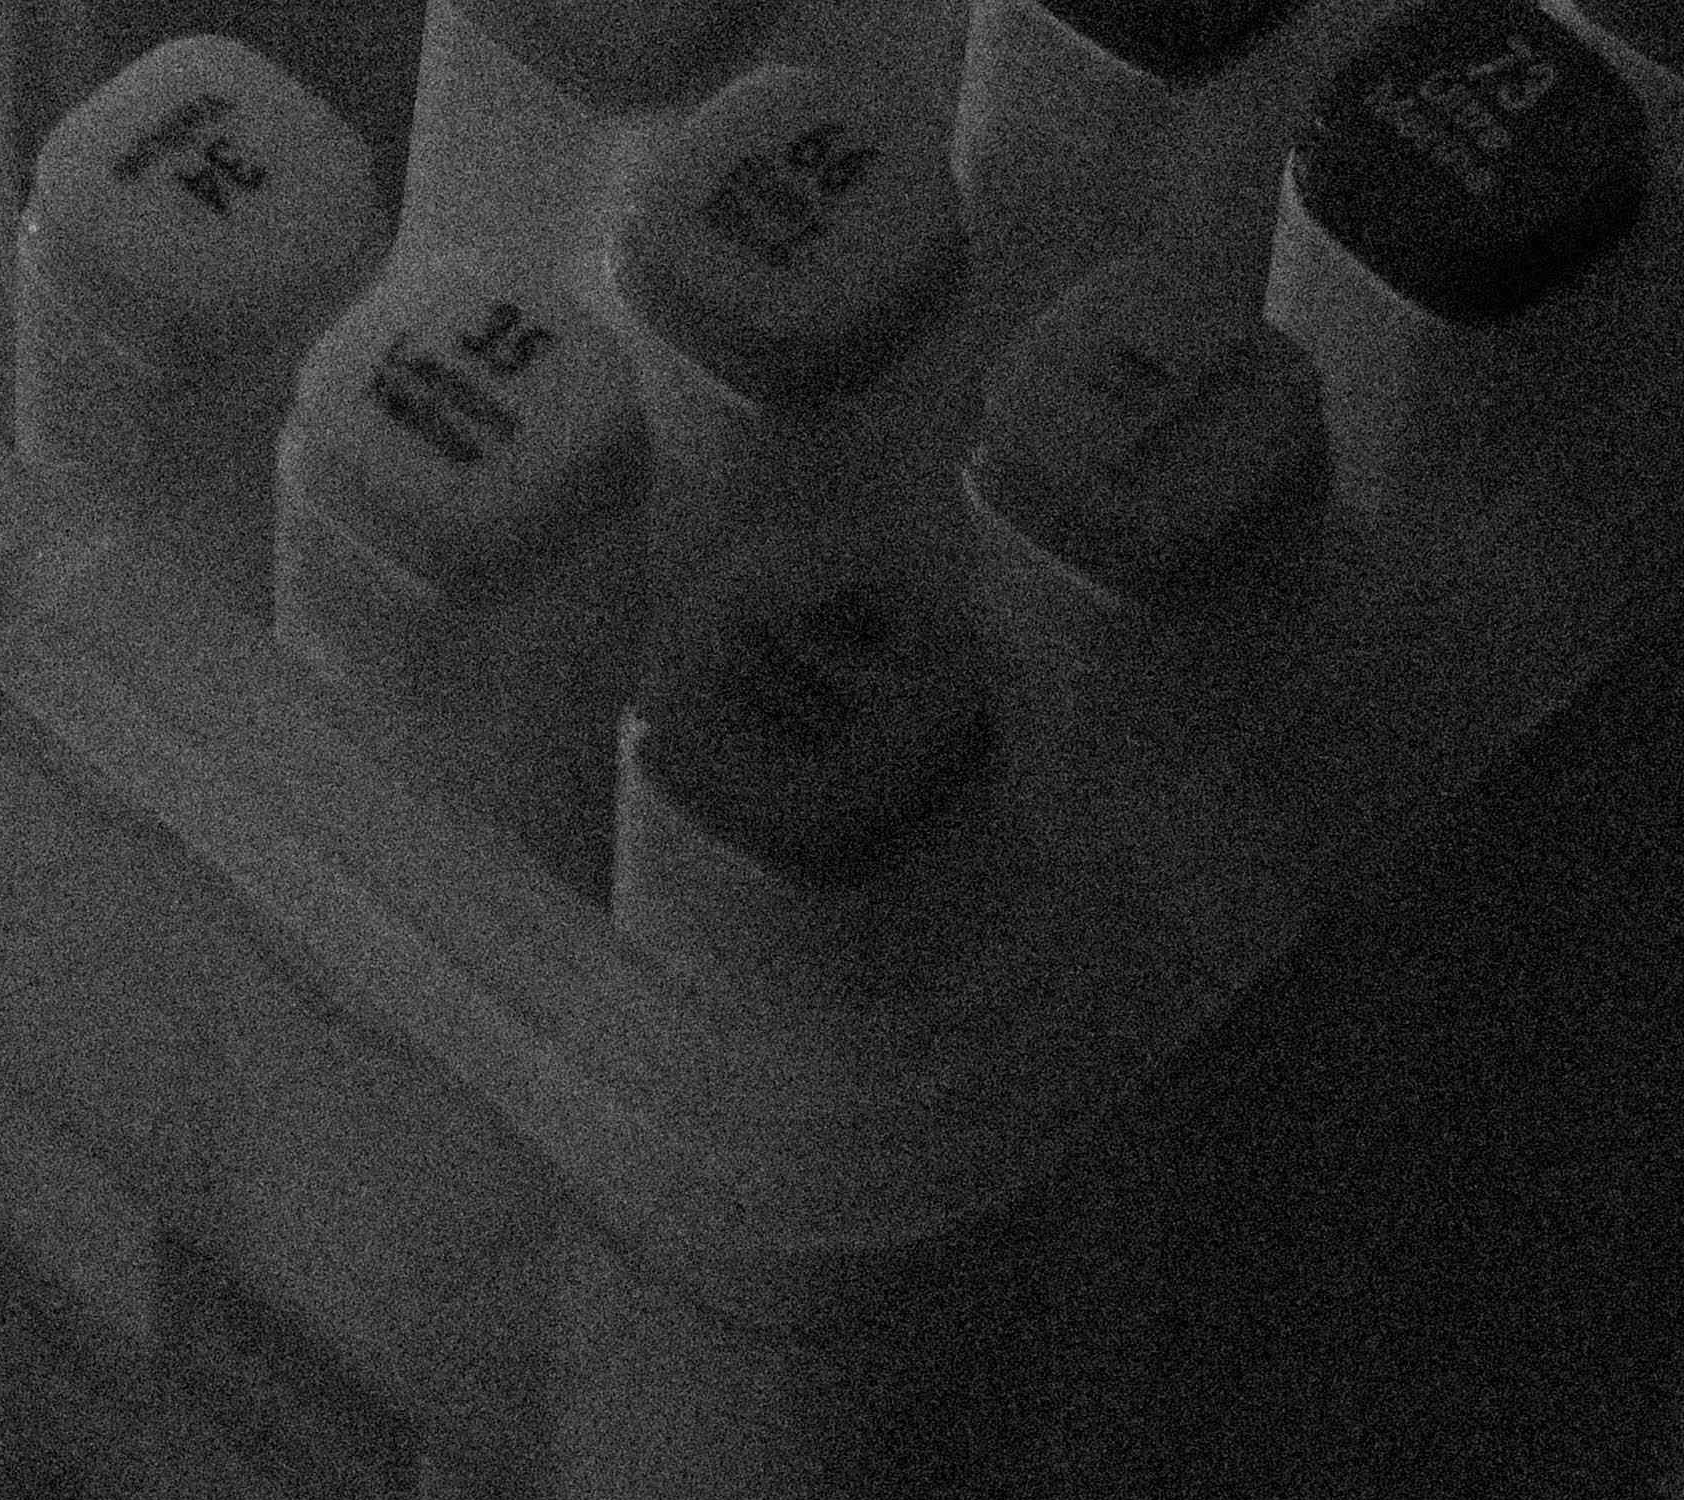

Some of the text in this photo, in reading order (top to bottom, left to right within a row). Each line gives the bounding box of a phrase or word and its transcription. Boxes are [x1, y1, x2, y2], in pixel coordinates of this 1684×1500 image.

[1465, 32, 1561, 114] 73
[172, 136, 270, 218] 34
[784, 121, 881, 196] 66
